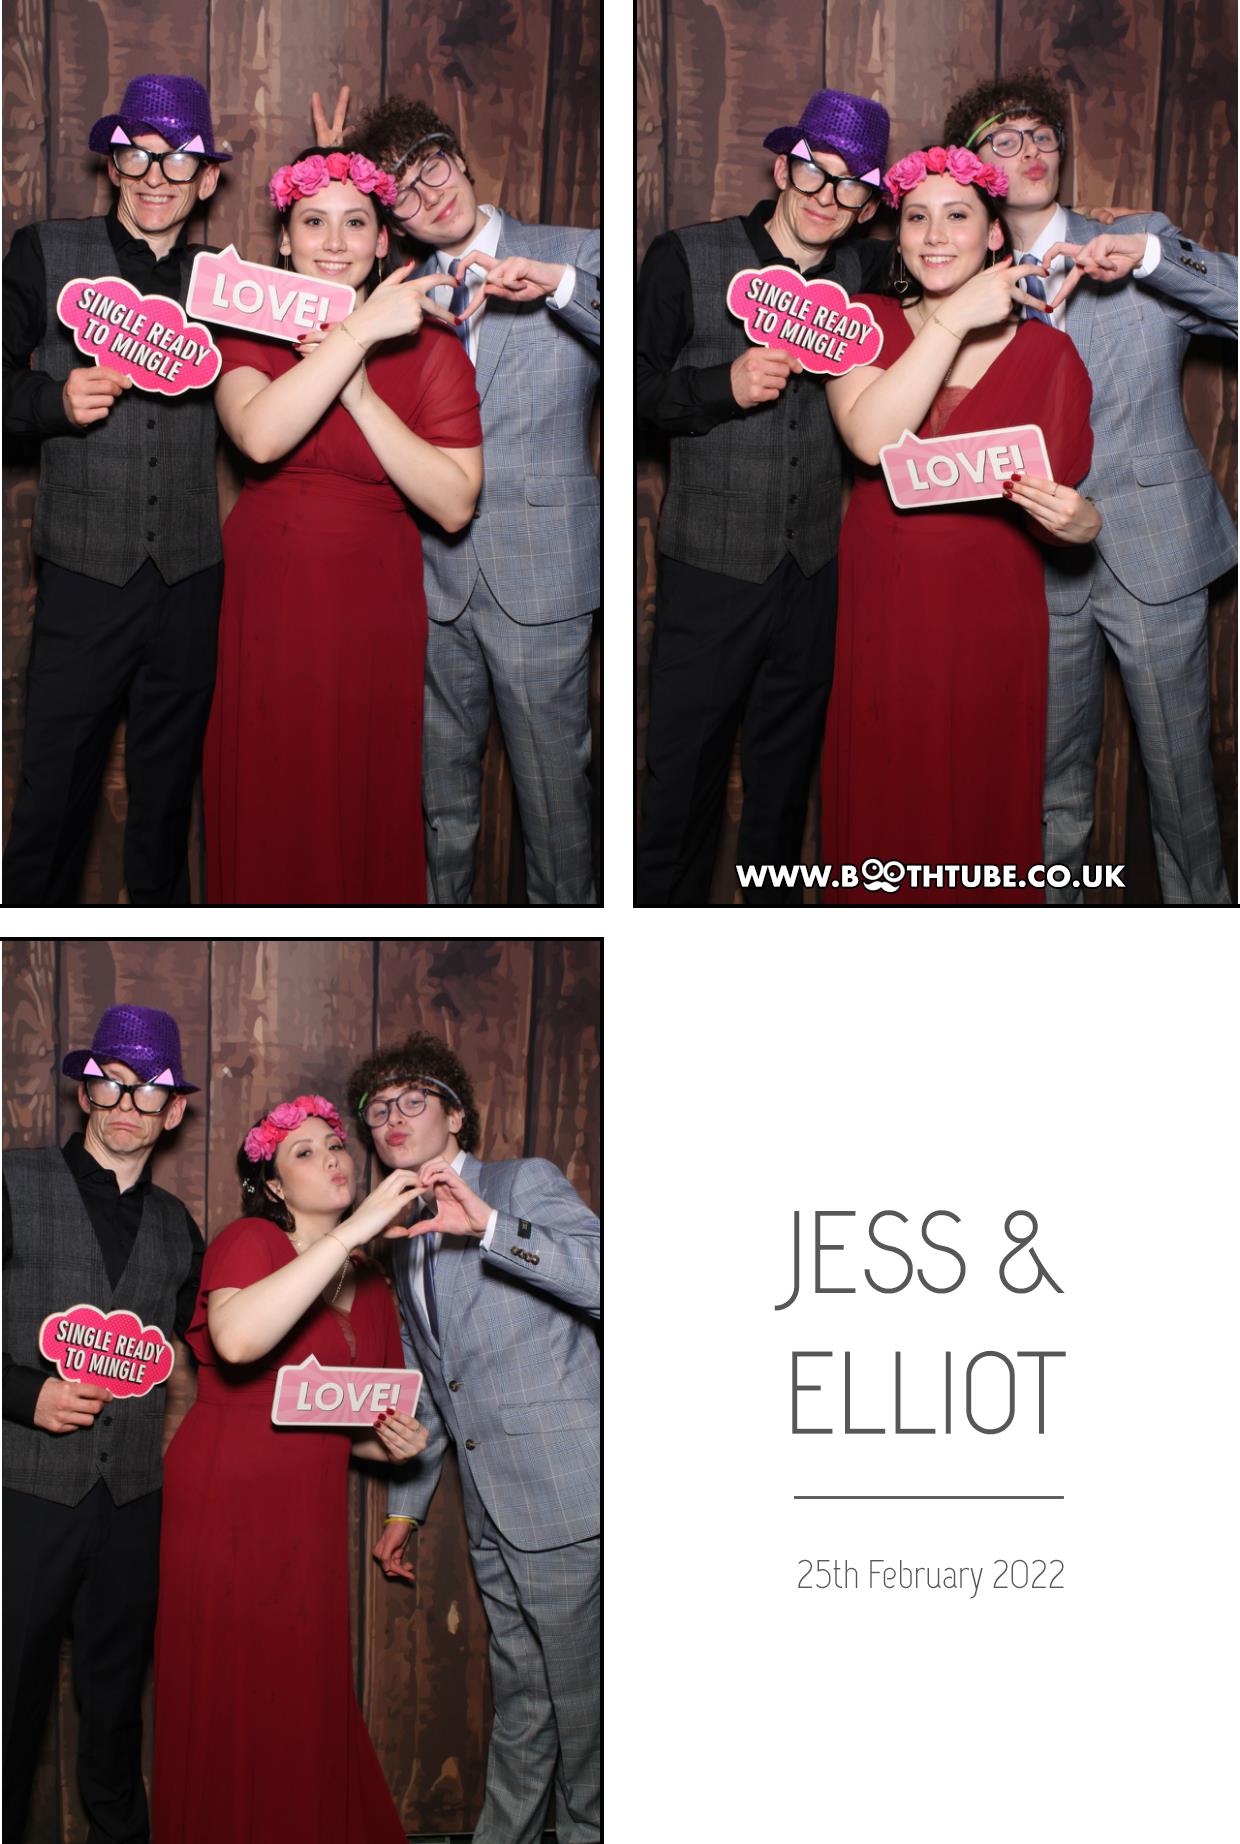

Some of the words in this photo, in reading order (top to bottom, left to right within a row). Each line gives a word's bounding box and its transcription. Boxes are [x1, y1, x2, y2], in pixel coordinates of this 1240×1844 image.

[77, 288, 147, 336] SINGLE
[145, 321, 211, 367] READY
[212, 273, 330, 331] LOVE!
[746, 277, 813, 321] SINGLE
[812, 305, 873, 345] READY
[83, 317, 110, 346] TO
[109, 332, 183, 382] MINGLE
[752, 307, 779, 334] TO
[778, 319, 848, 363] MINGLE
[906, 444, 1026, 491] LOVE!
[55, 1320, 113, 1352] SINGLE
[114, 1335, 165, 1364] READY
[65, 1347, 86, 1370] TO
[88, 1353, 147, 1384] MINGLE
[296, 1381, 402, 1412] LOVE!
